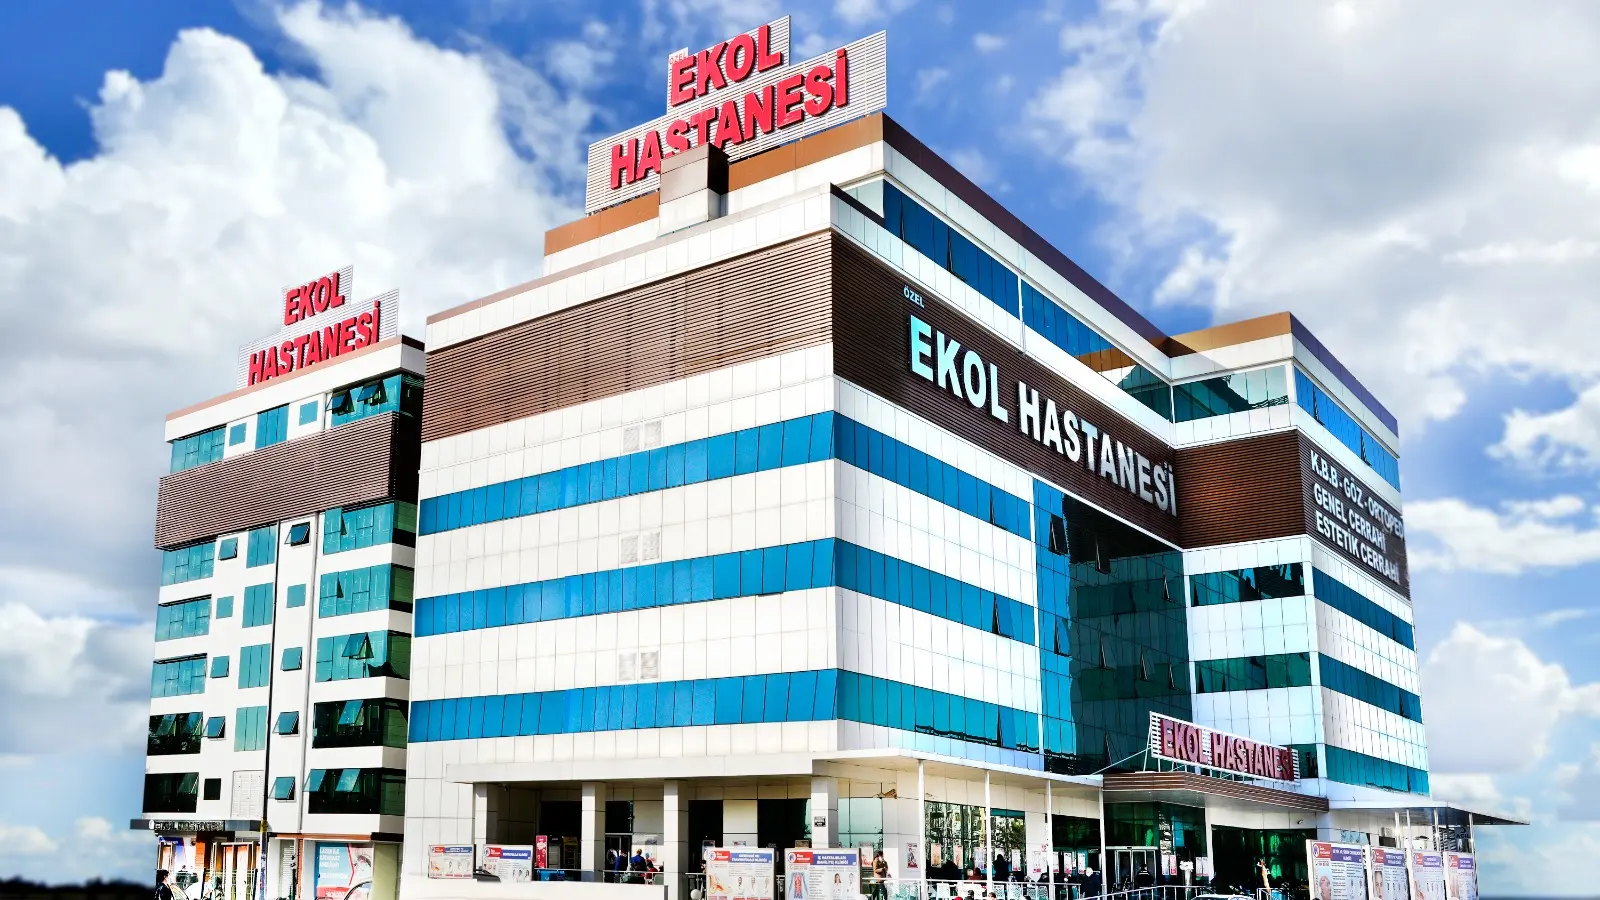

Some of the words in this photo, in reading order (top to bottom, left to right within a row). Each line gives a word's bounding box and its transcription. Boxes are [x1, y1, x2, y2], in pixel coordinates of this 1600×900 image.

[672, 24, 782, 107] EKOL
[610, 48, 849, 190] HASTANESİ
[284, 272, 345, 326] EKOL
[903, 285, 925, 309] ÖZEL
[248, 300, 381, 386] HASTANESİ
[909, 314, 1009, 424] EKOL
[1018, 380, 1177, 517] HASTANESİ
[1313, 482, 1347, 524] GENEL
[1343, 476, 1364, 509] GÖZ
[1315, 509, 1359, 559] ESTETİK
[1160, 718, 1208, 764] EKOL
